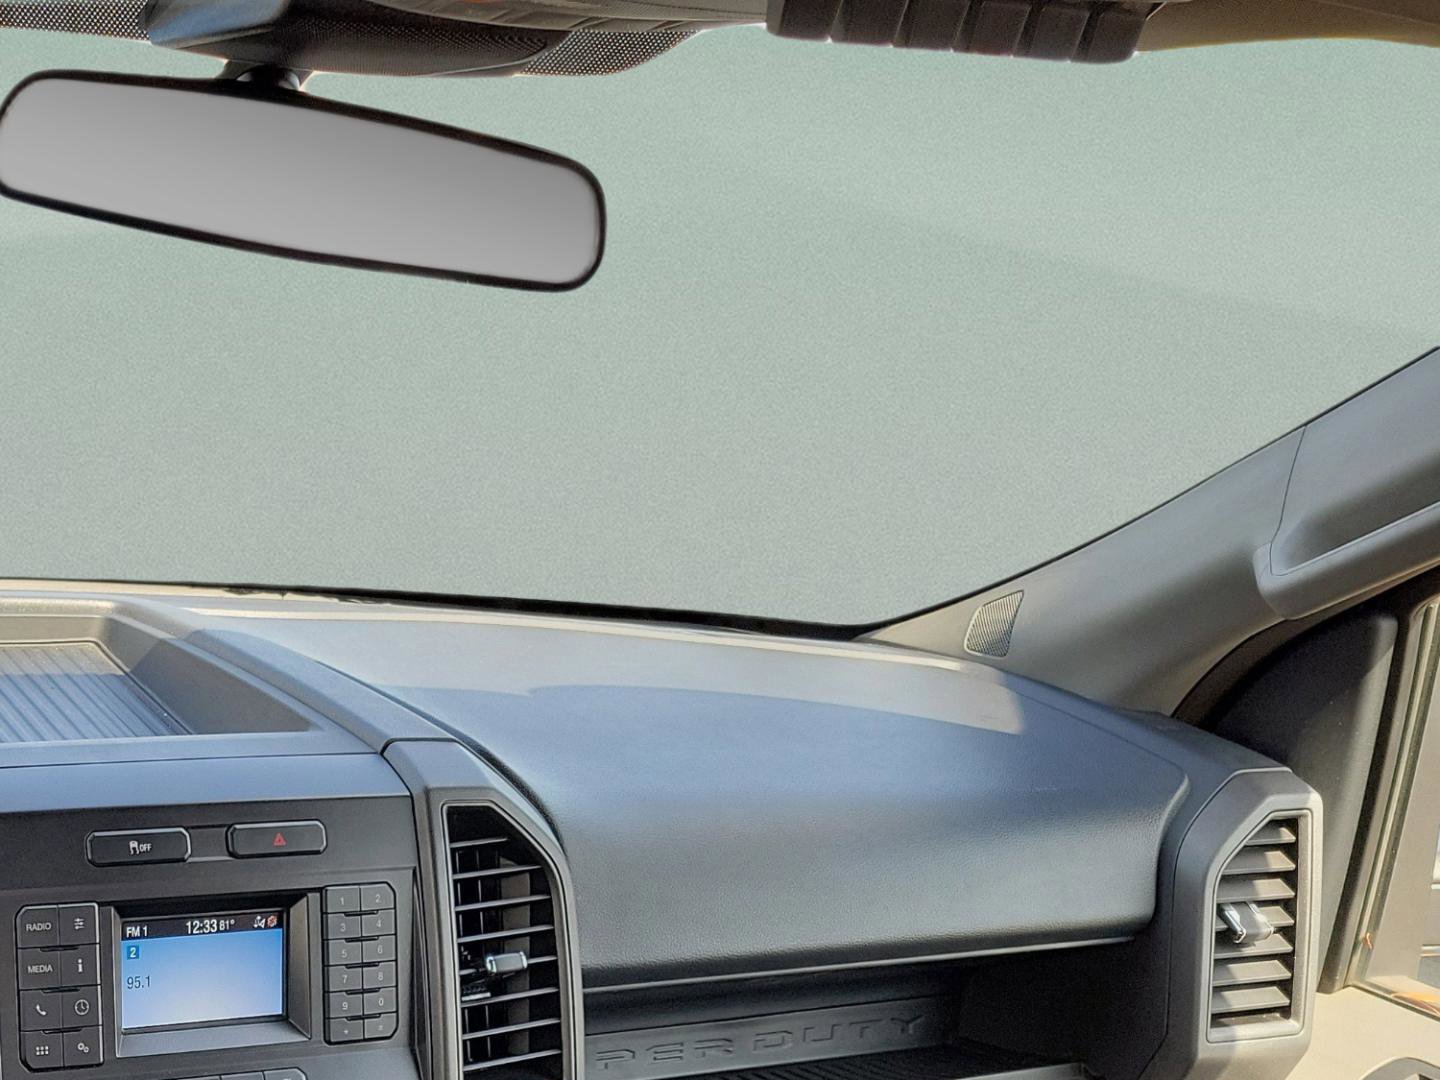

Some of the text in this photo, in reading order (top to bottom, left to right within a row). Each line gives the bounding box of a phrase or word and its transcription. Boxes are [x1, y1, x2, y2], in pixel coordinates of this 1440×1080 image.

[139, 842, 152, 853] OFF
[25, 922, 52, 932] RADIO
[126, 926, 141, 938] FM
[186, 919, 218, 934] 12:33
[27, 964, 53, 974] MEDIA
[127, 975, 151, 990] 95.1
[751, 1014, 925, 1054] DUTY
